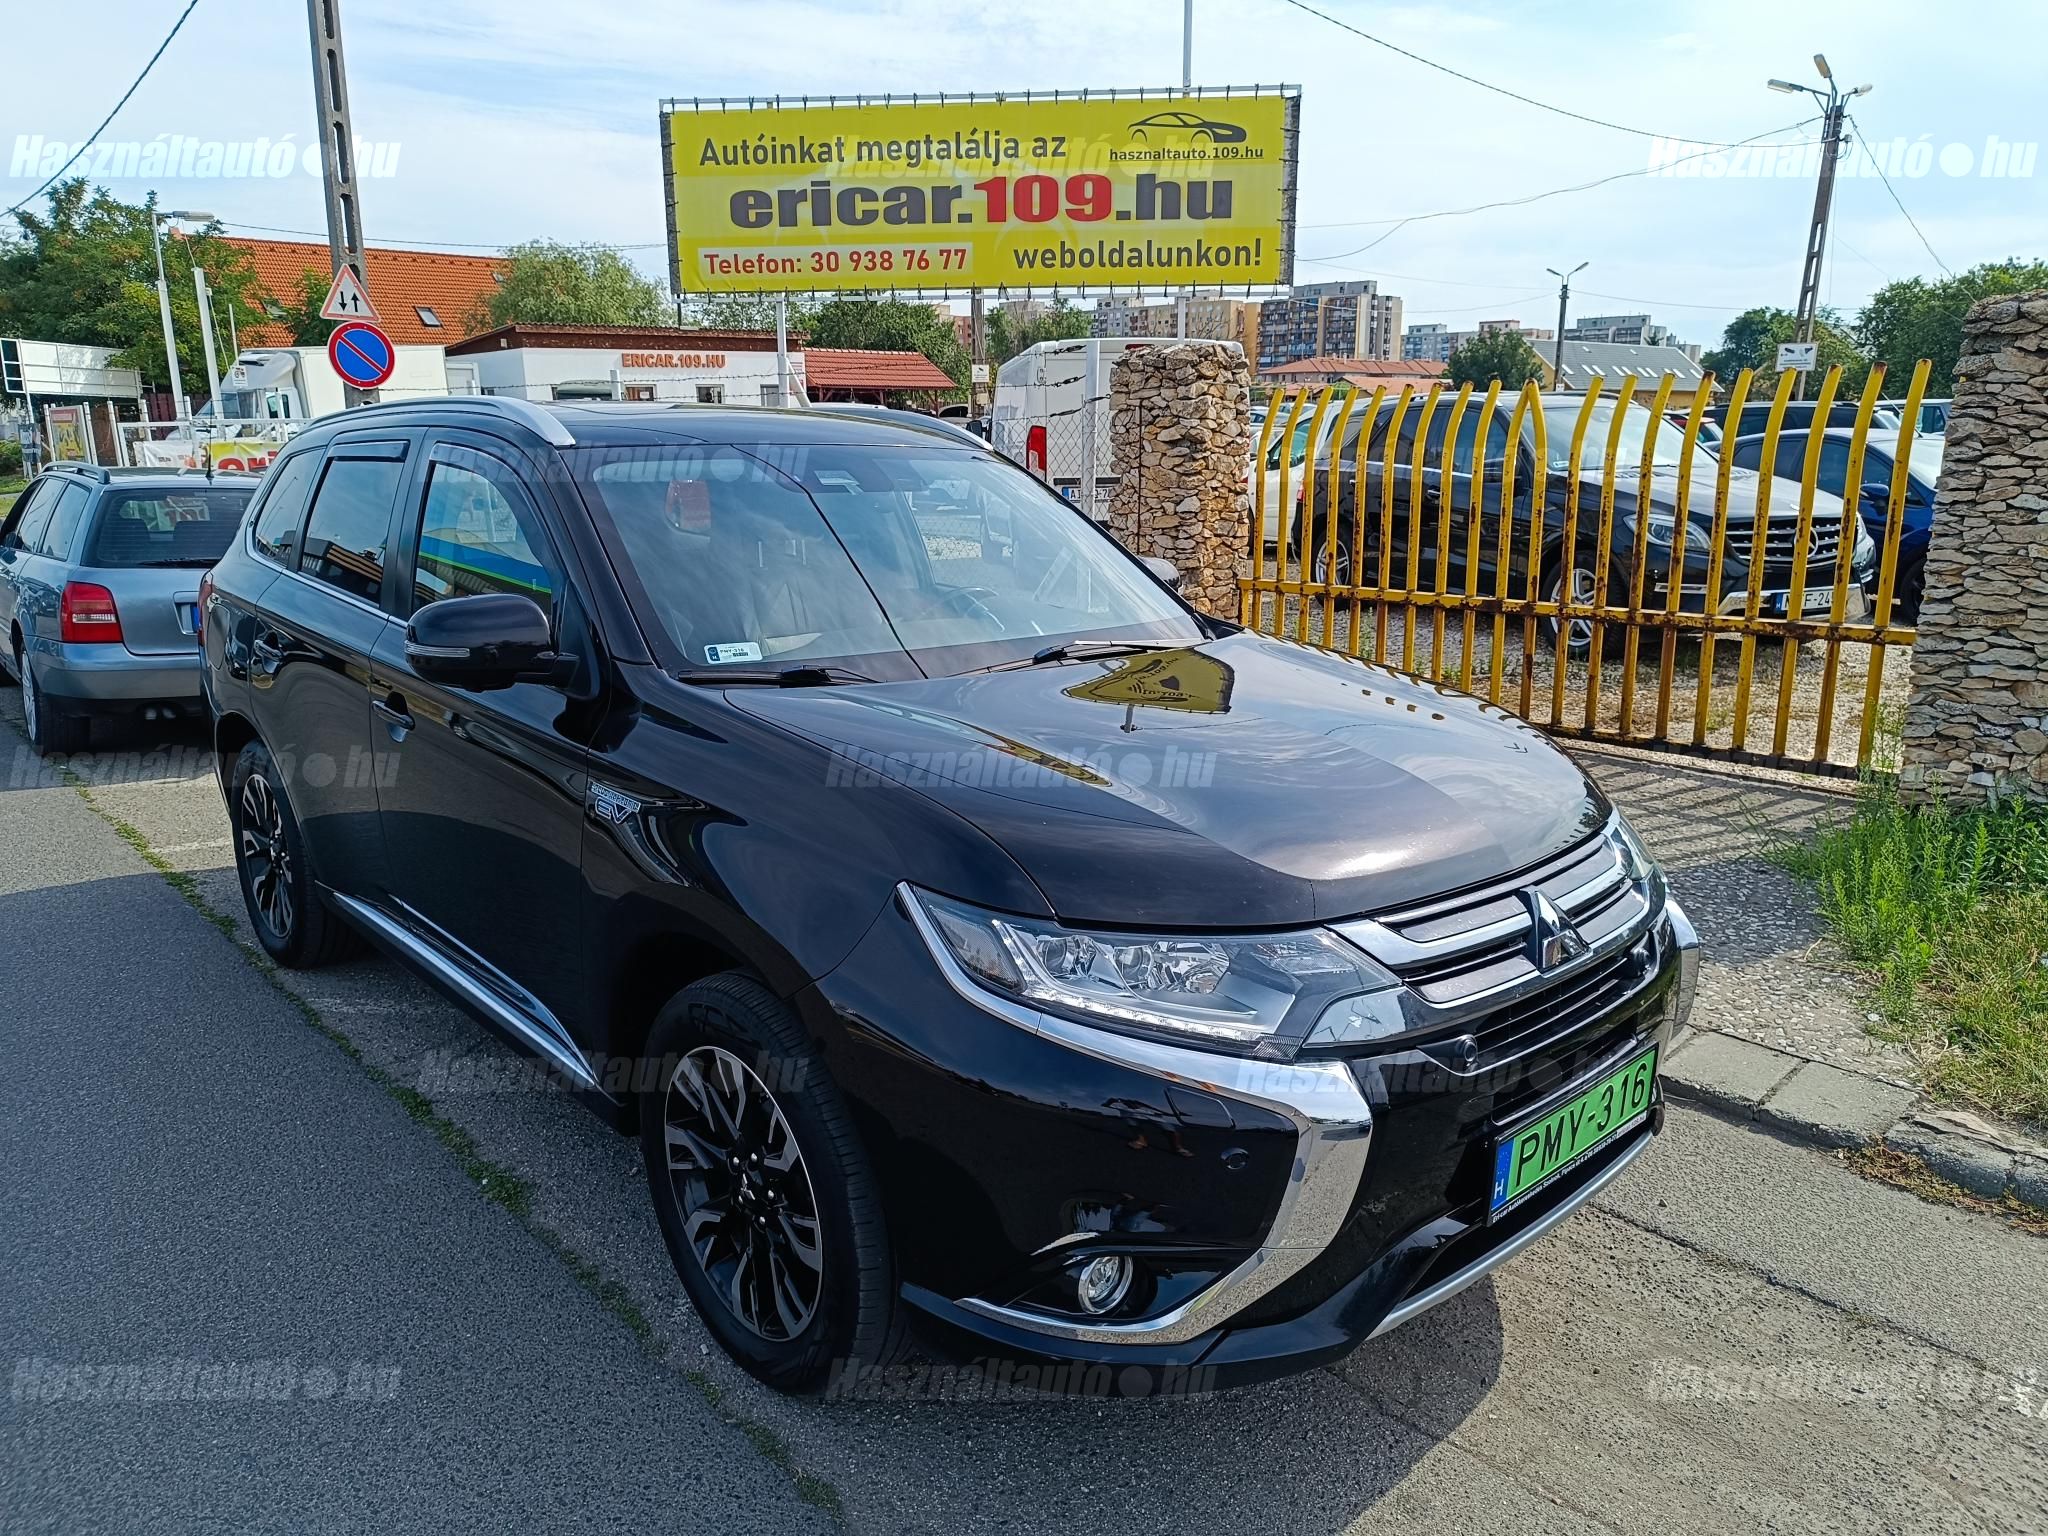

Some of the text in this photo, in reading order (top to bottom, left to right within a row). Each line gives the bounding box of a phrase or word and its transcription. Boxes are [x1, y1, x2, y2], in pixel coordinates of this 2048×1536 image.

[699, 127, 1066, 168] Autóinkat megtalálja az
[1109, 146, 1264, 161] hasznaltauto.109.hu
[729, 172, 1233, 229] ericar.109.hu
[704, 248, 967, 275] Telefon: 30 938 76 77
[1013, 238, 1262, 269] weboldalunkon!
[621, 353, 726, 369] ERICAR.109.HU
[1493, 1178, 1504, 1200] H
[1515, 1061, 1648, 1188] PMY-316
